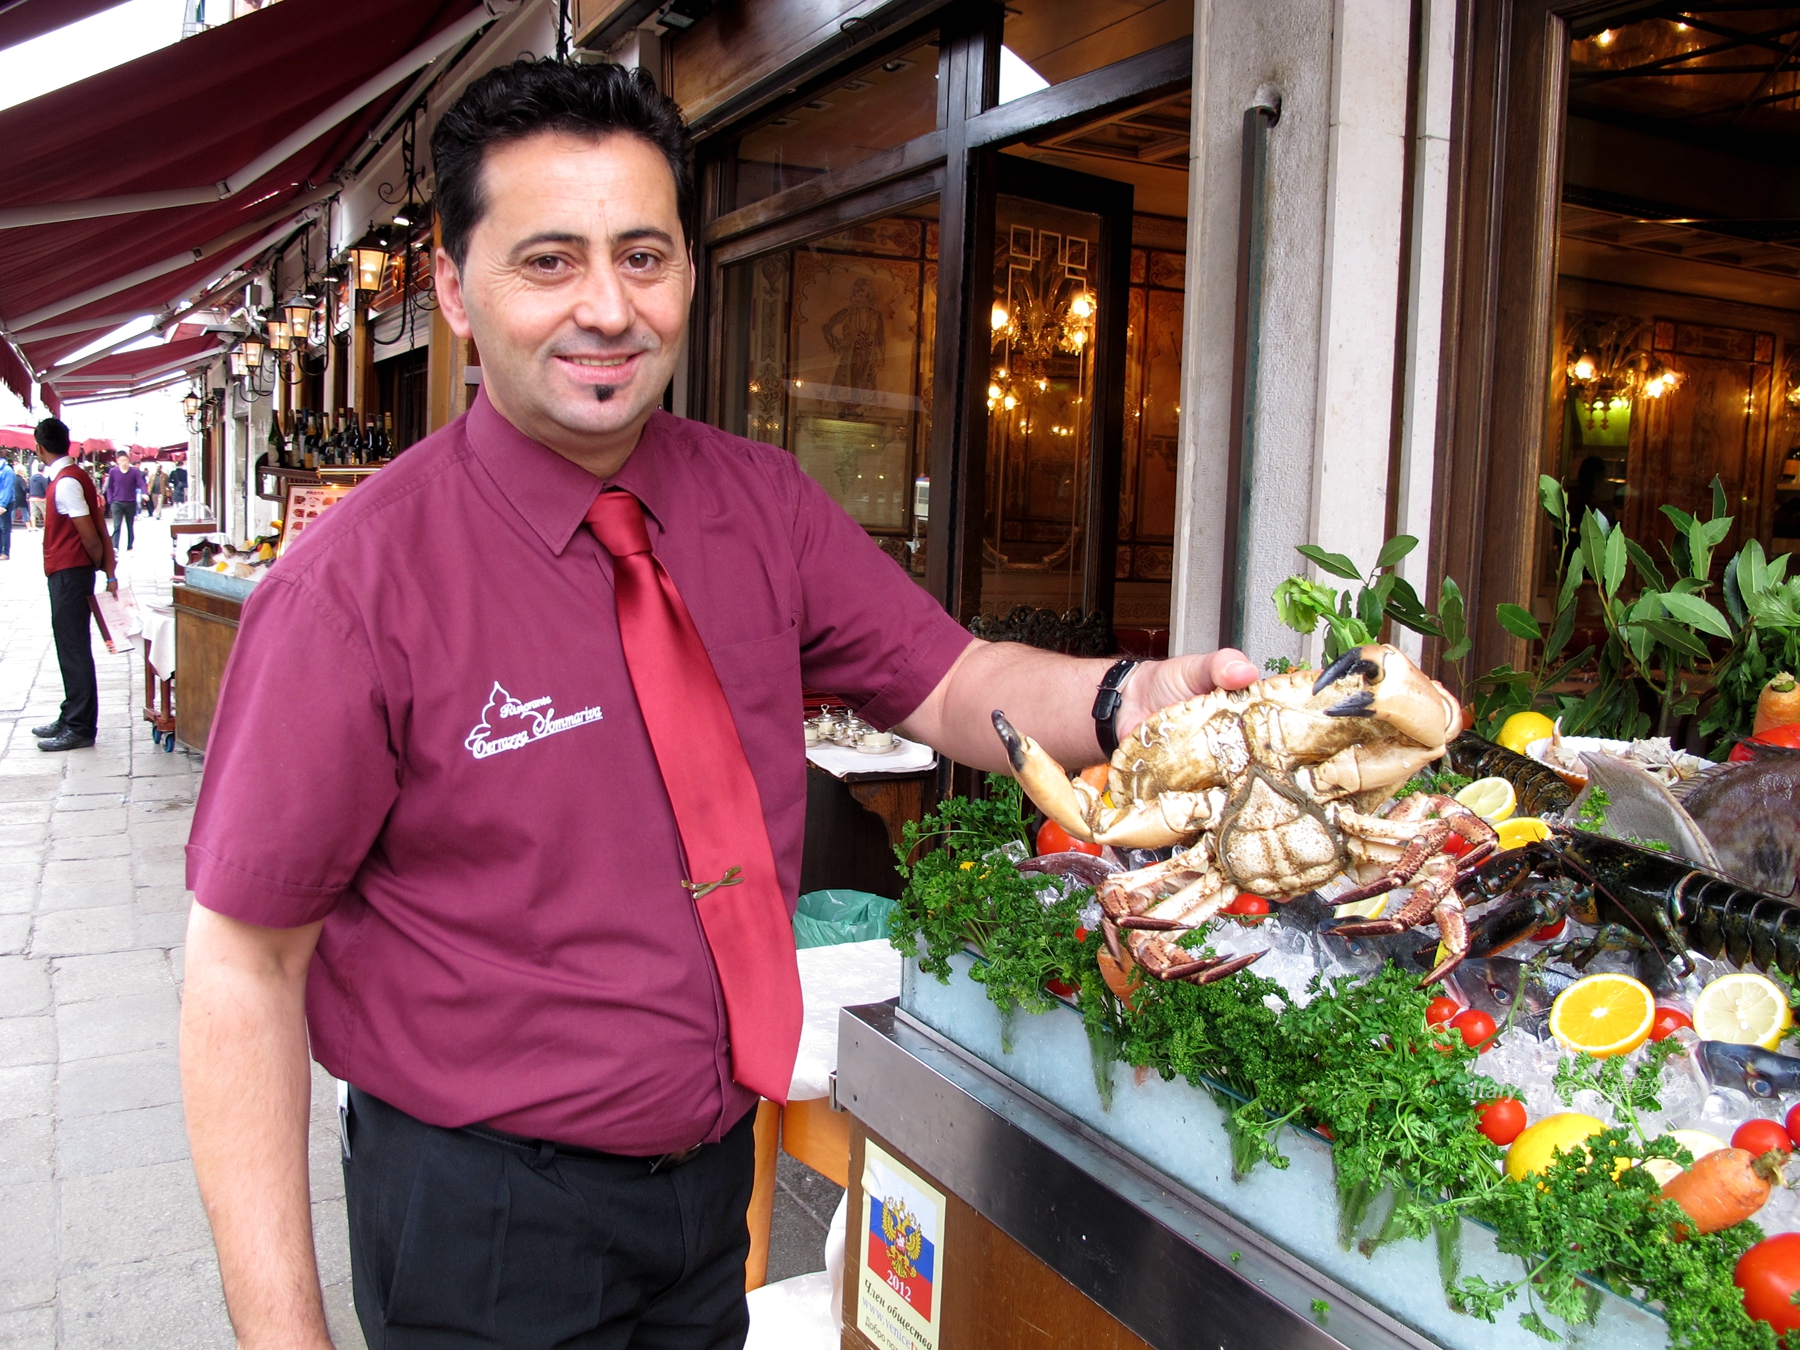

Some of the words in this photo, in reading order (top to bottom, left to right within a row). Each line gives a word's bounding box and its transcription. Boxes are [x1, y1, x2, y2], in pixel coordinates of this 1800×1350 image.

[500, 695, 553, 718] Ristorante
[465, 730, 530, 759] Terrazza
[521, 706, 603, 737] Sommariva
[887, 1269, 911, 1303] 2012
[864, 1279, 885, 1308] Член
[887, 1304, 933, 1350] общества
[865, 1316, 886, 1342] Добро
[886, 1338, 899, 1350] по
